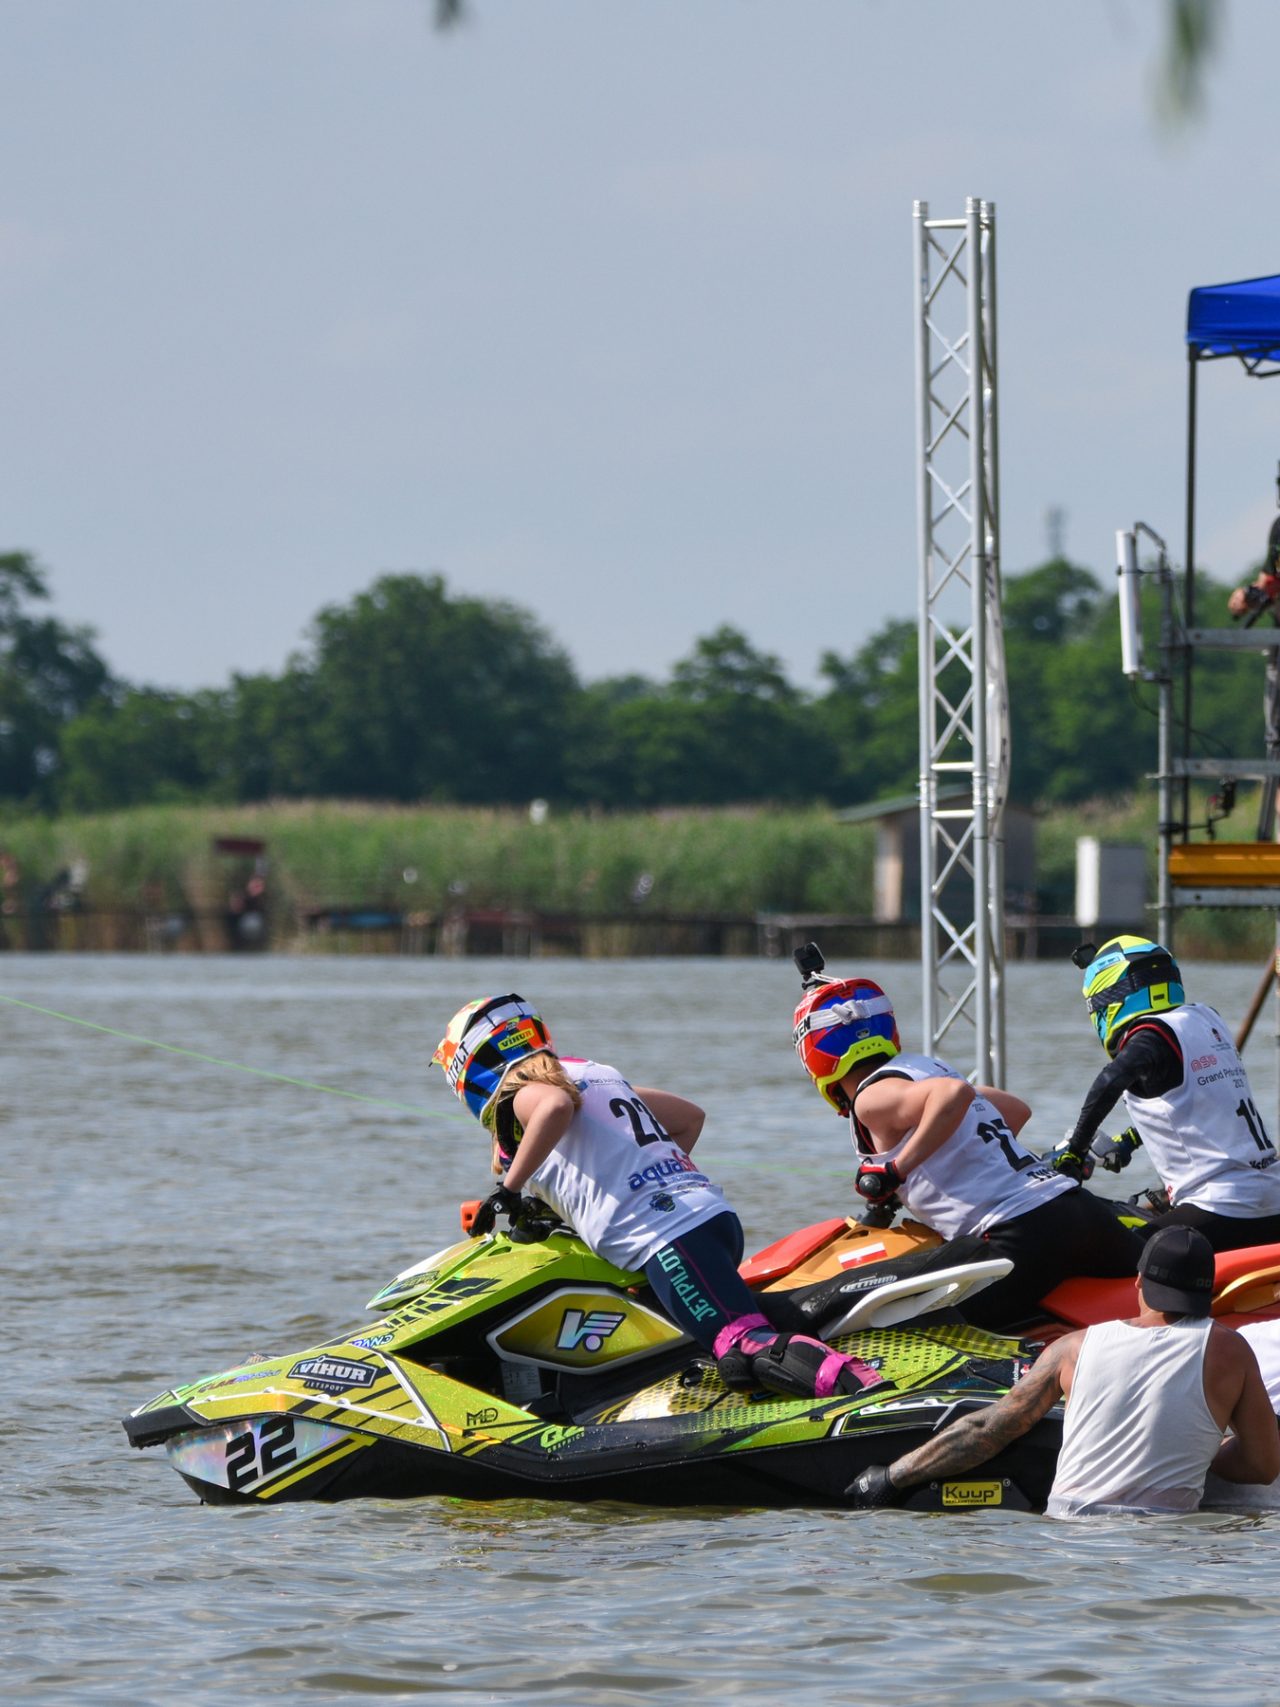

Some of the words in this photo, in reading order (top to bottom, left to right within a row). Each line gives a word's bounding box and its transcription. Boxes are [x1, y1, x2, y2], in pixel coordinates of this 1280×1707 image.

[609, 1097, 673, 1147] 22
[656, 1247, 718, 1322] JETPILOT
[299, 1362, 367, 1382] VIHUR
[225, 1413, 298, 1493] 22
